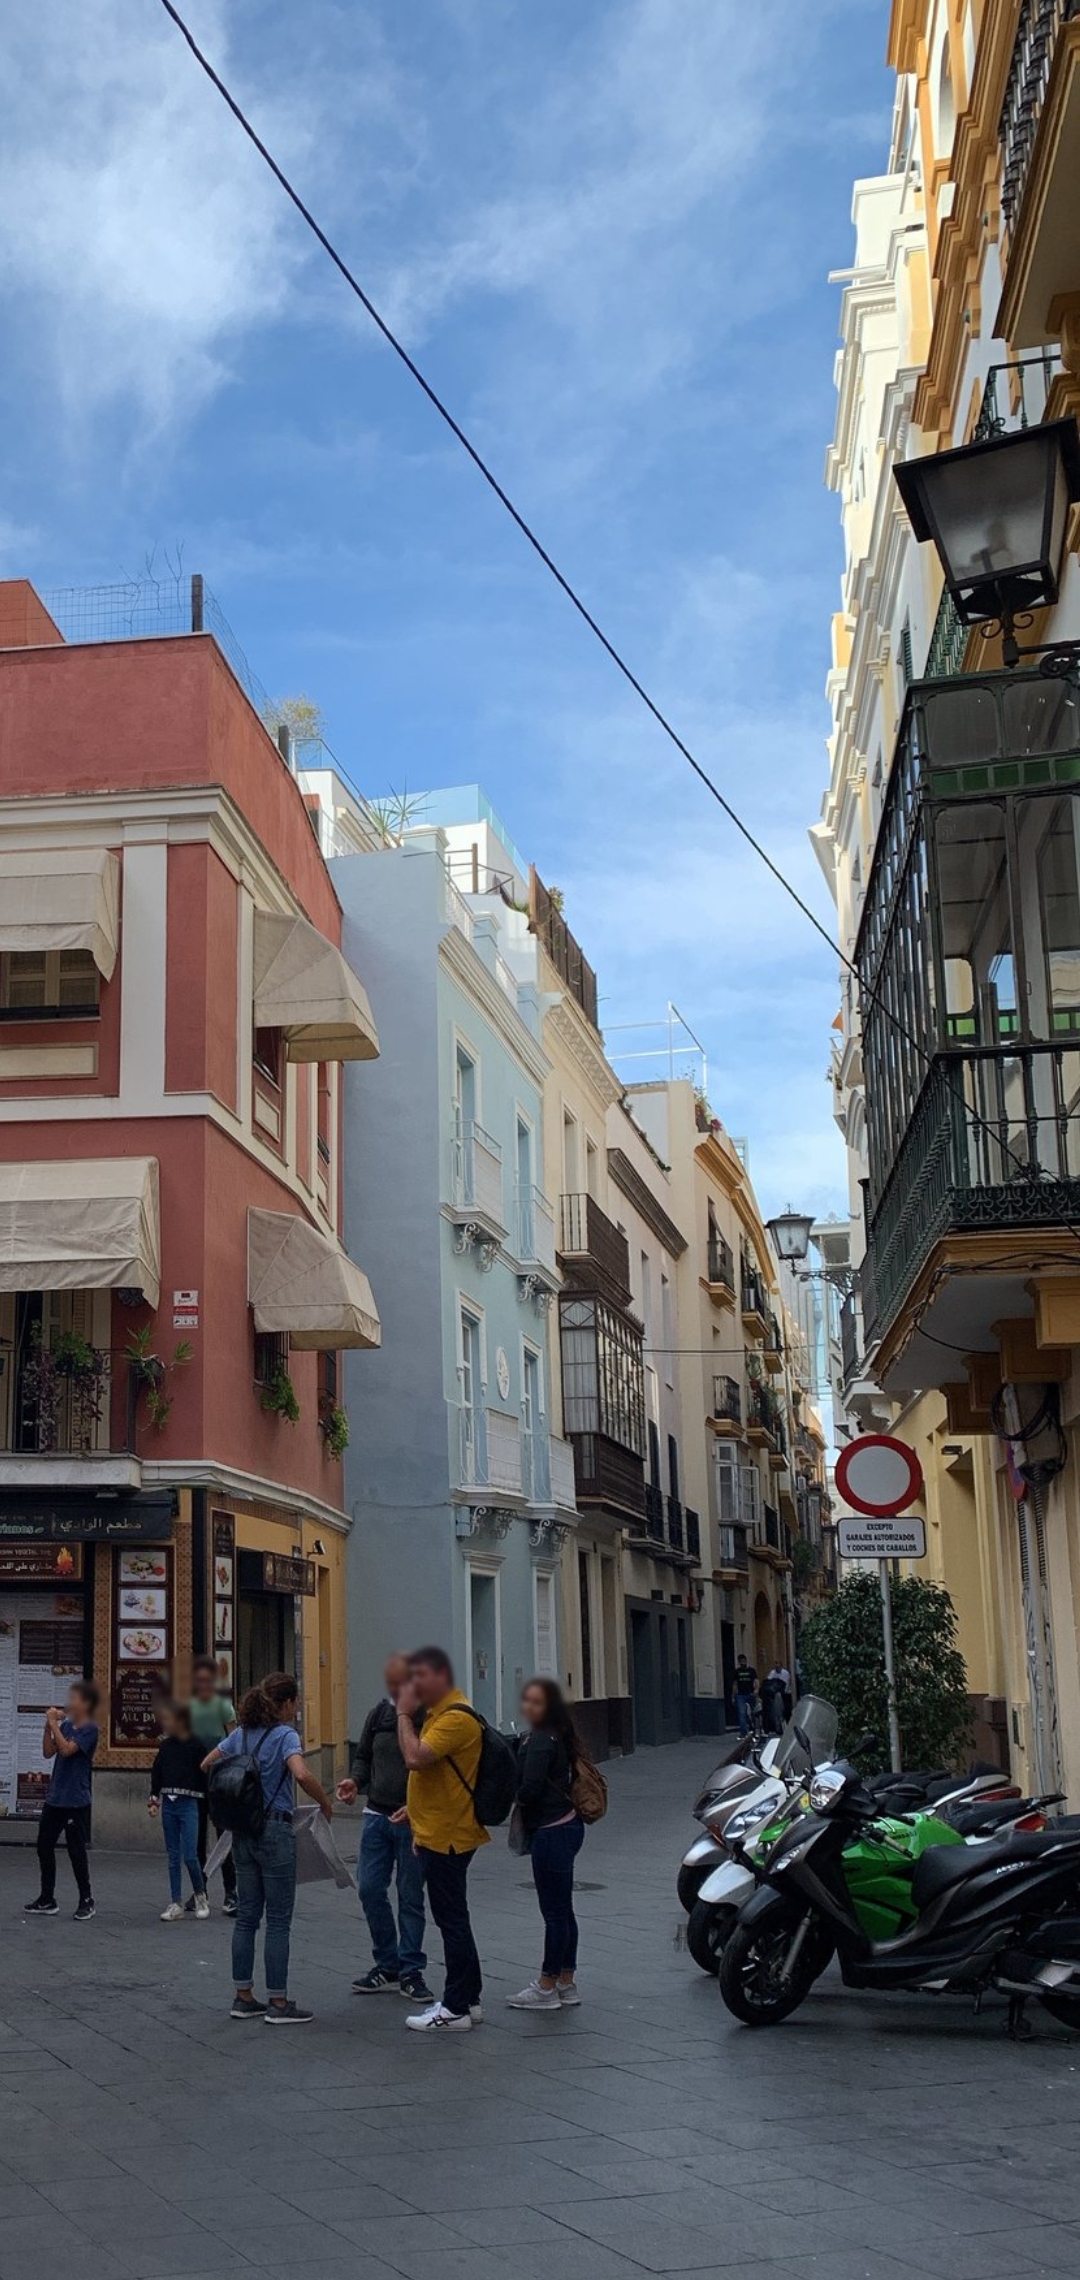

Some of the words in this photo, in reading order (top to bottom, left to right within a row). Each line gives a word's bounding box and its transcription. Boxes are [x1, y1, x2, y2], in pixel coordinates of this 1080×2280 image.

[106, 1518, 142, 1534] مطعم
[866, 1523, 893, 1531] EXCEPTO
[873, 1533, 915, 1541] AUTORIZADOS
[847, 1544, 851, 1552] Y
[852, 1544, 876, 1552] COCHES
[877, 1544, 885, 1552] DE
[886, 1543, 917, 1552] CABALLOS
[121, 1712, 139, 1722] ALL
[143, 1713, 156, 1723] DA
